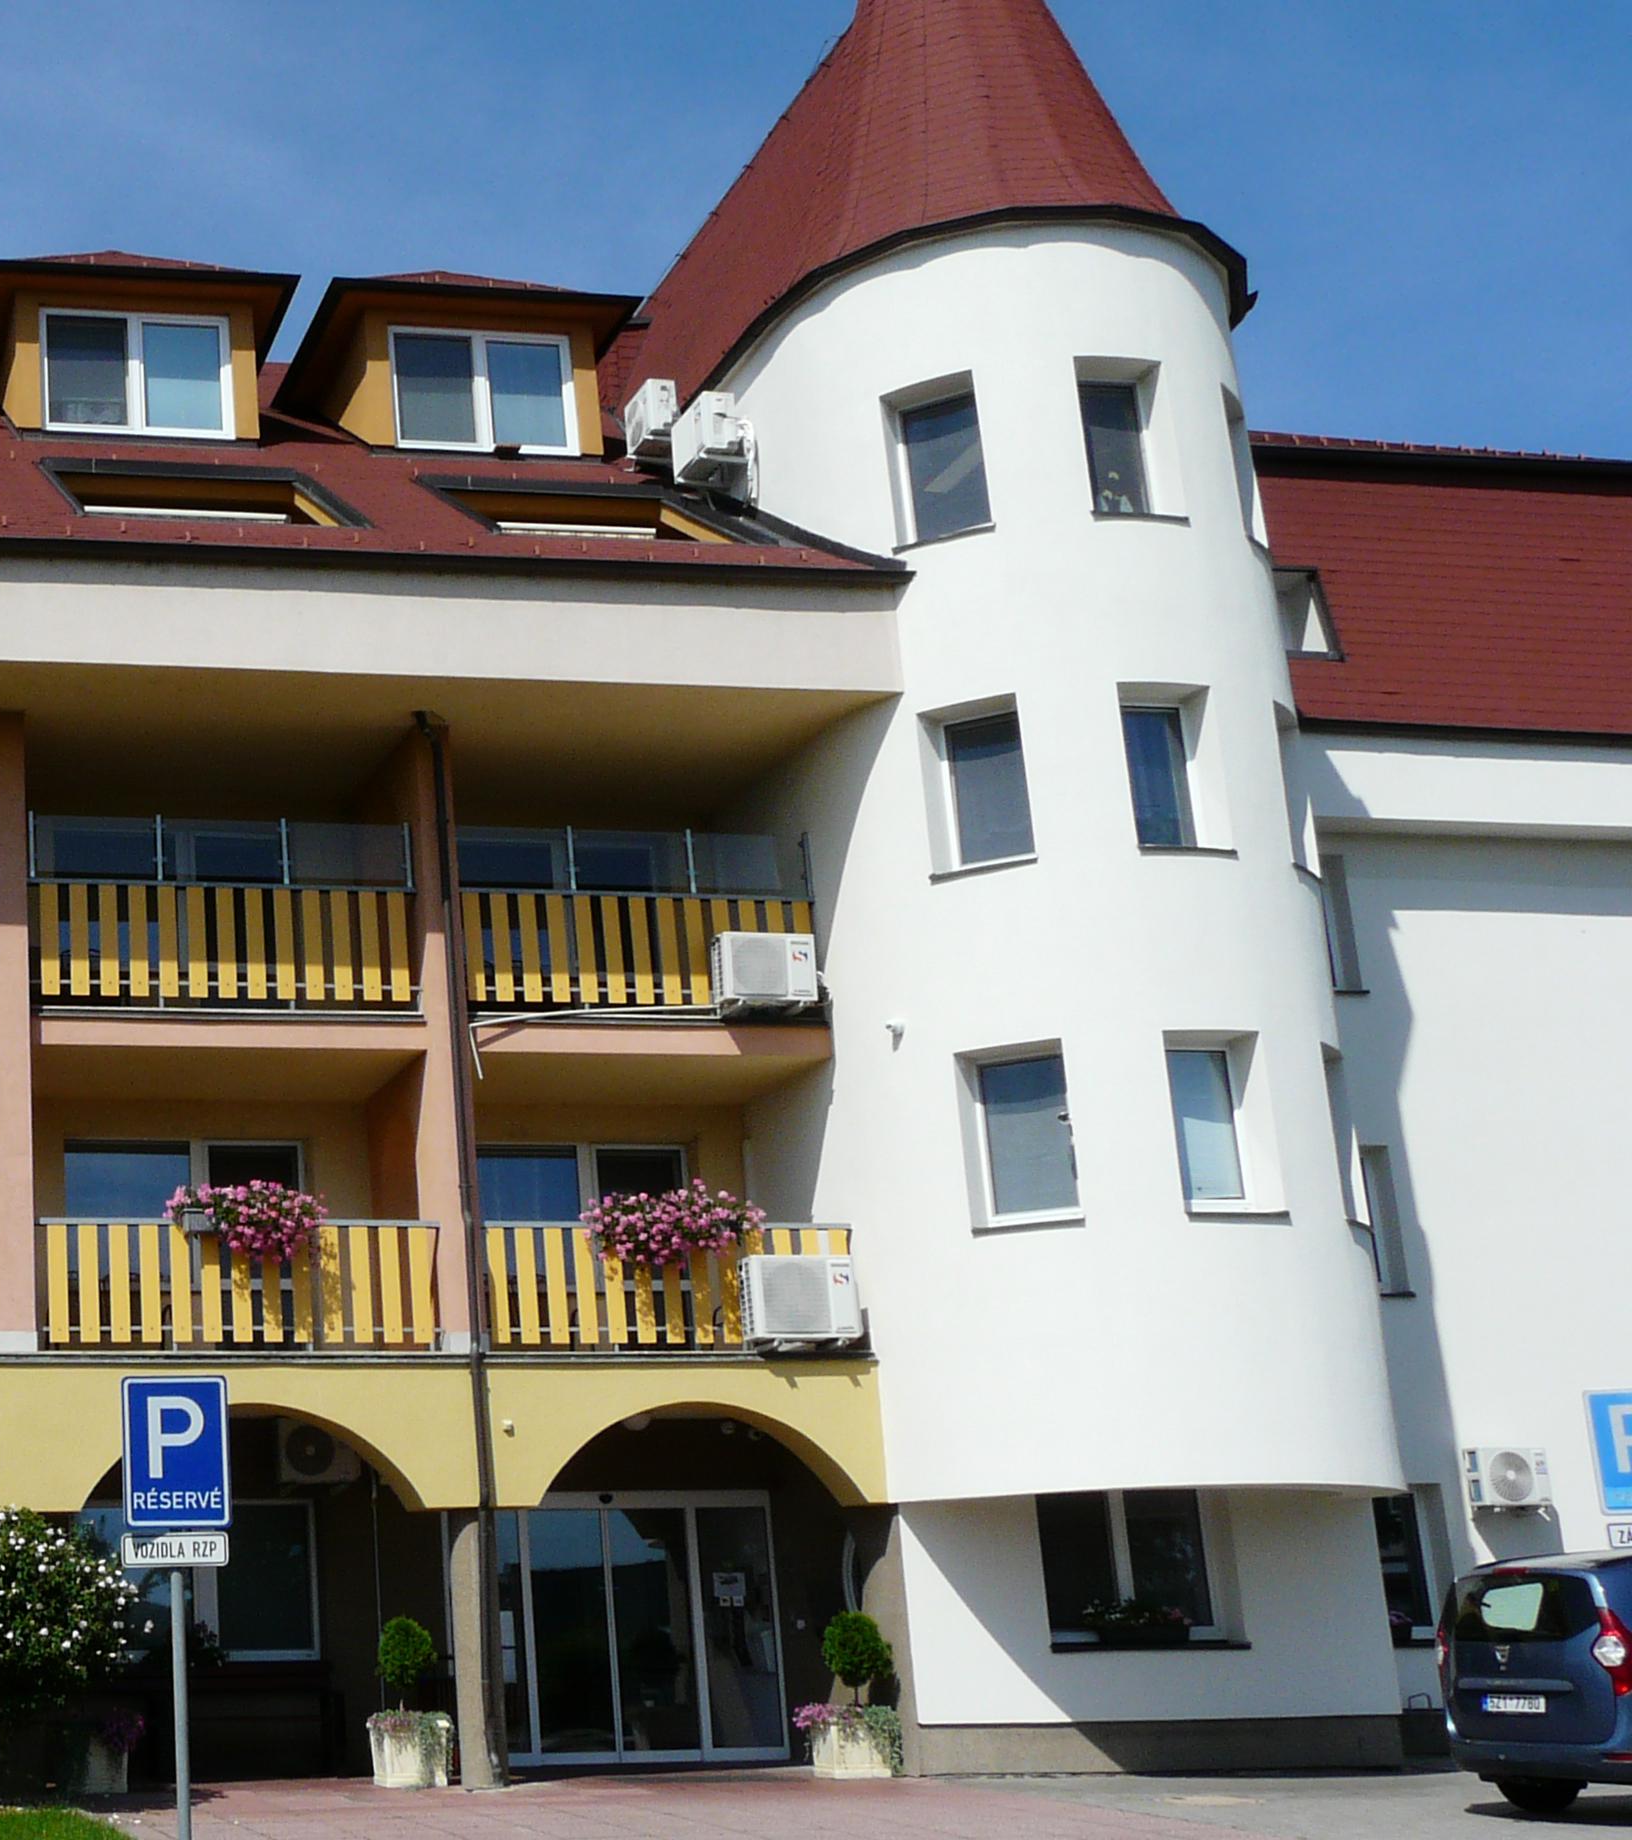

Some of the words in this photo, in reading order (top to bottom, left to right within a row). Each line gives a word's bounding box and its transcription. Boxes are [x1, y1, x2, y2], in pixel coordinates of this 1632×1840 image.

[147, 1396, 205, 1479] P
[132, 1486, 222, 1510] RÉSERVÉ
[132, 1541, 186, 1559] VOZIDLA
[192, 1540, 217, 1558] RZP
